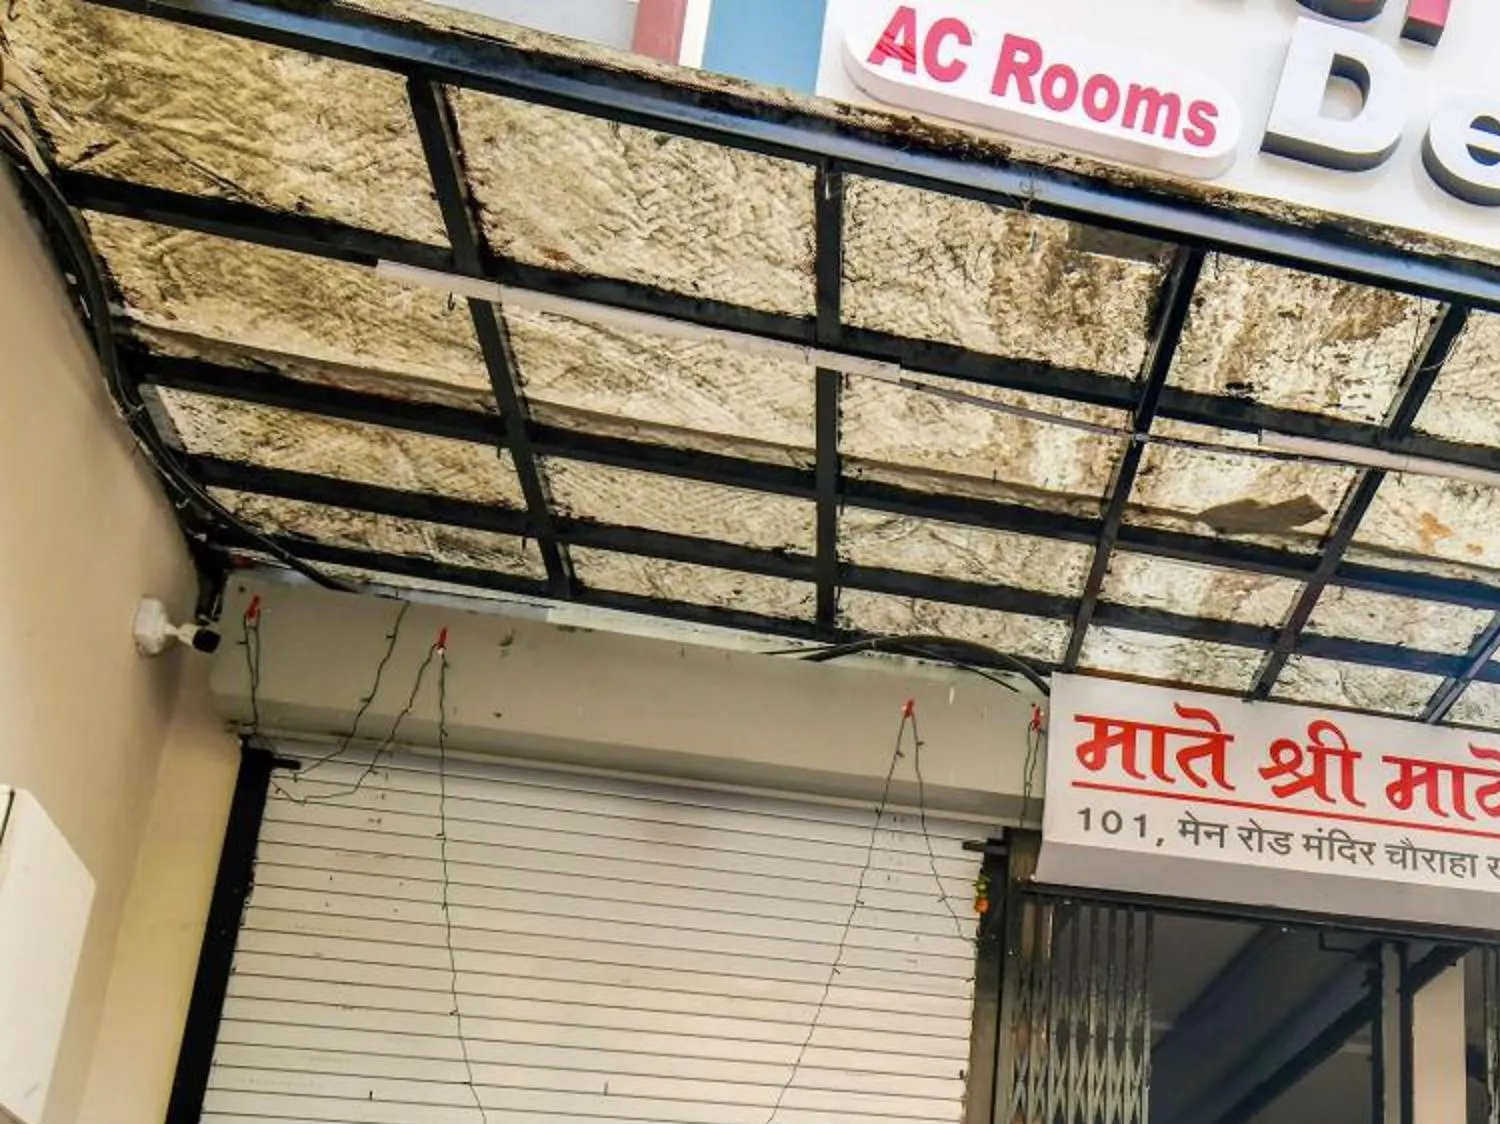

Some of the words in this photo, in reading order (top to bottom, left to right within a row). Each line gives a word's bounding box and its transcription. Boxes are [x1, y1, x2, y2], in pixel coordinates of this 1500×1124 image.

[866, 5, 973, 83] AC
[990, 33, 1219, 148] Rooms
[1074, 702, 1236, 791] माते
[1259, 719, 1366, 808] श्री
[1177, 810, 1229, 848] मेन
[1237, 818, 1294, 855] रोड
[1302, 828, 1377, 865] मंदिर
[1384, 837, 1479, 878] चौराहा
